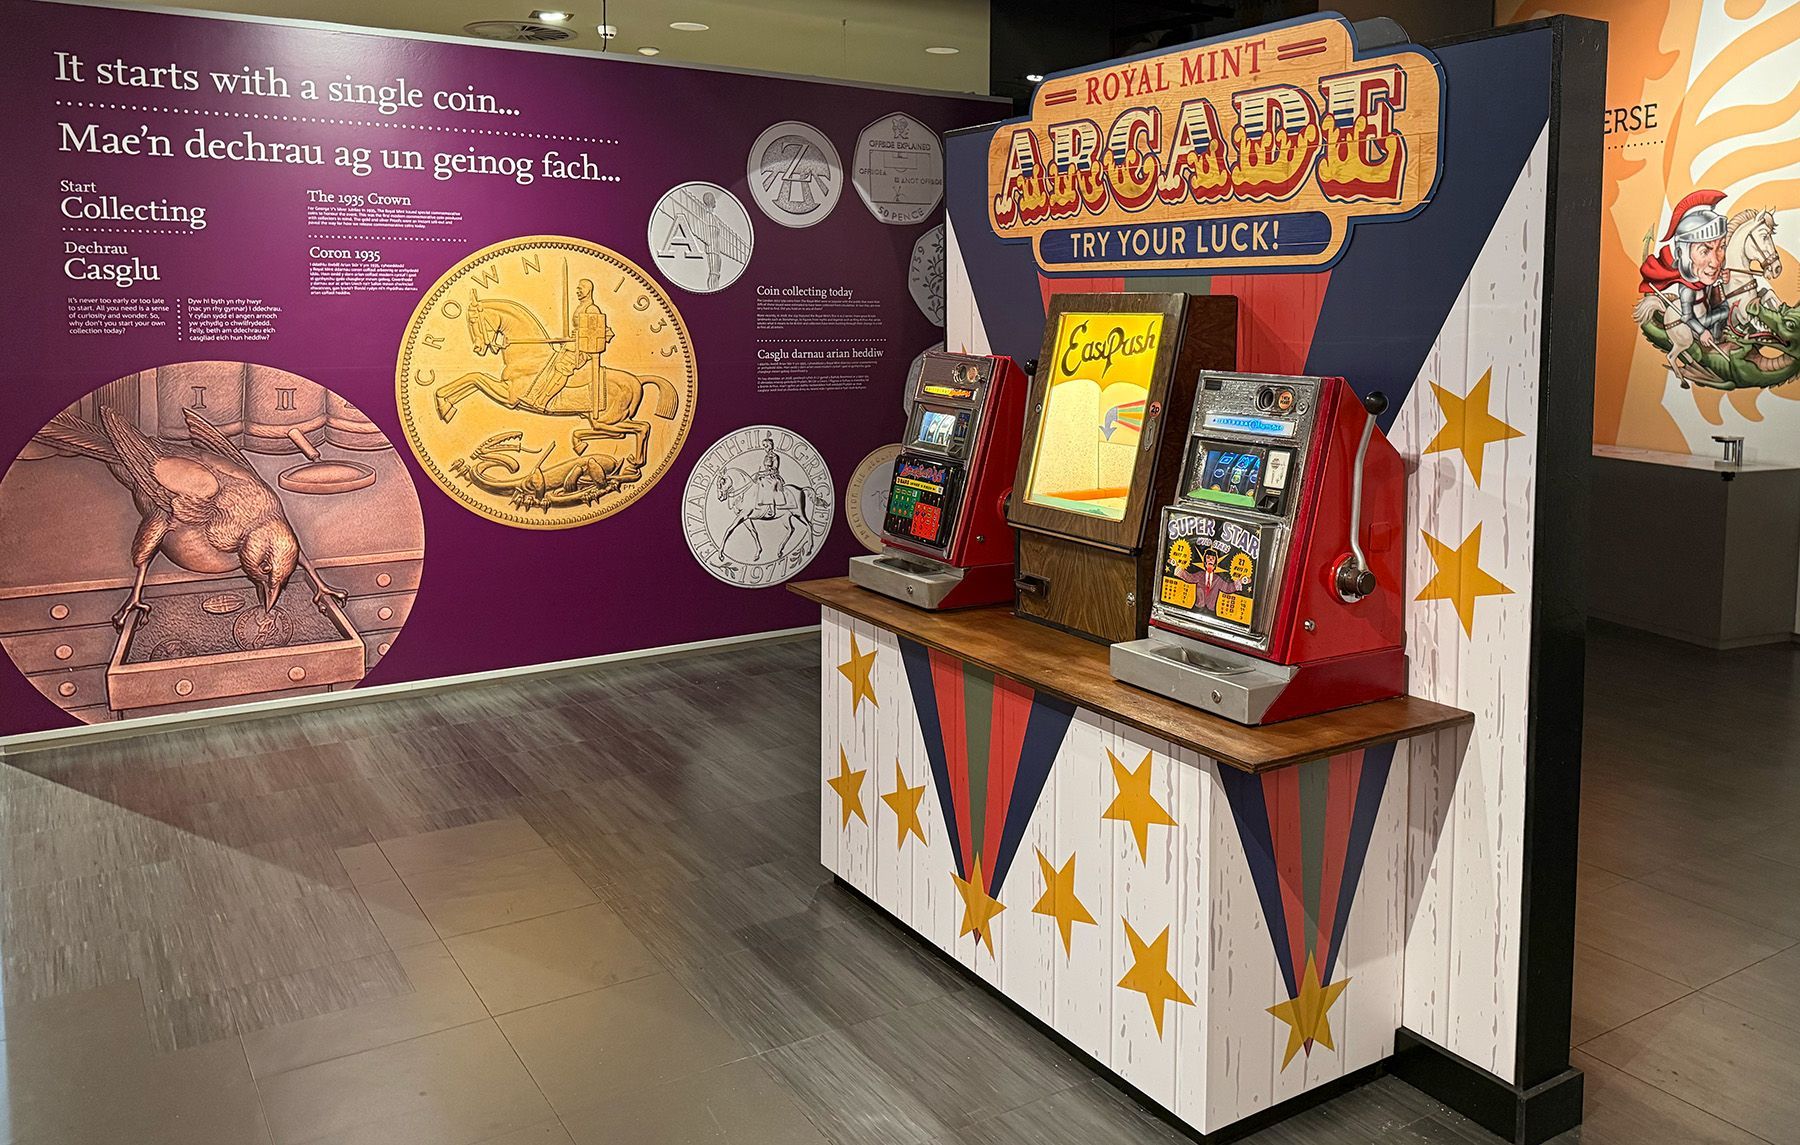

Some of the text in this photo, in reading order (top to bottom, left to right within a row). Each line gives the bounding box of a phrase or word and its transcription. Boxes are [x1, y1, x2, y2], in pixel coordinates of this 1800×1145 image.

[54, 51, 520, 116] It starts with a single coin...
[1085, 38, 1266, 105] ROYAL MINT
[58, 122, 621, 185] Mae’n dechrau ag un geinog fach...
[994, 63, 1407, 228] ARCADE
[60, 179, 97, 193] Start
[307, 190, 412, 207] The 1935 Crown
[60, 196, 207, 230] Collecting
[878, 206, 925, 221] 50 PENCE
[64, 241, 128, 255] Dechrau
[657, 212, 704, 260] A
[1070, 220, 1280, 258] TRY YOUR LUCK!
[309, 246, 381, 263] Coron 1935
[912, 245, 926, 283] 1759
[64, 257, 161, 288] Casglu
[113, 297, 129, 305] early
[756, 285, 853, 300] Coin collecting today
[104, 327, 126, 335] today?
[149, 312, 160, 320] So,
[416, 253, 678, 387] CROWN 1935
[757, 347, 884, 362] Casglu darnau arian heddiw
[1150, 404, 1160, 414] 2p
[686, 429, 761, 564] ELIZABETH II
[1168, 516, 1261, 559] SUPER STAR
[738, 555, 789, 584] 1977
